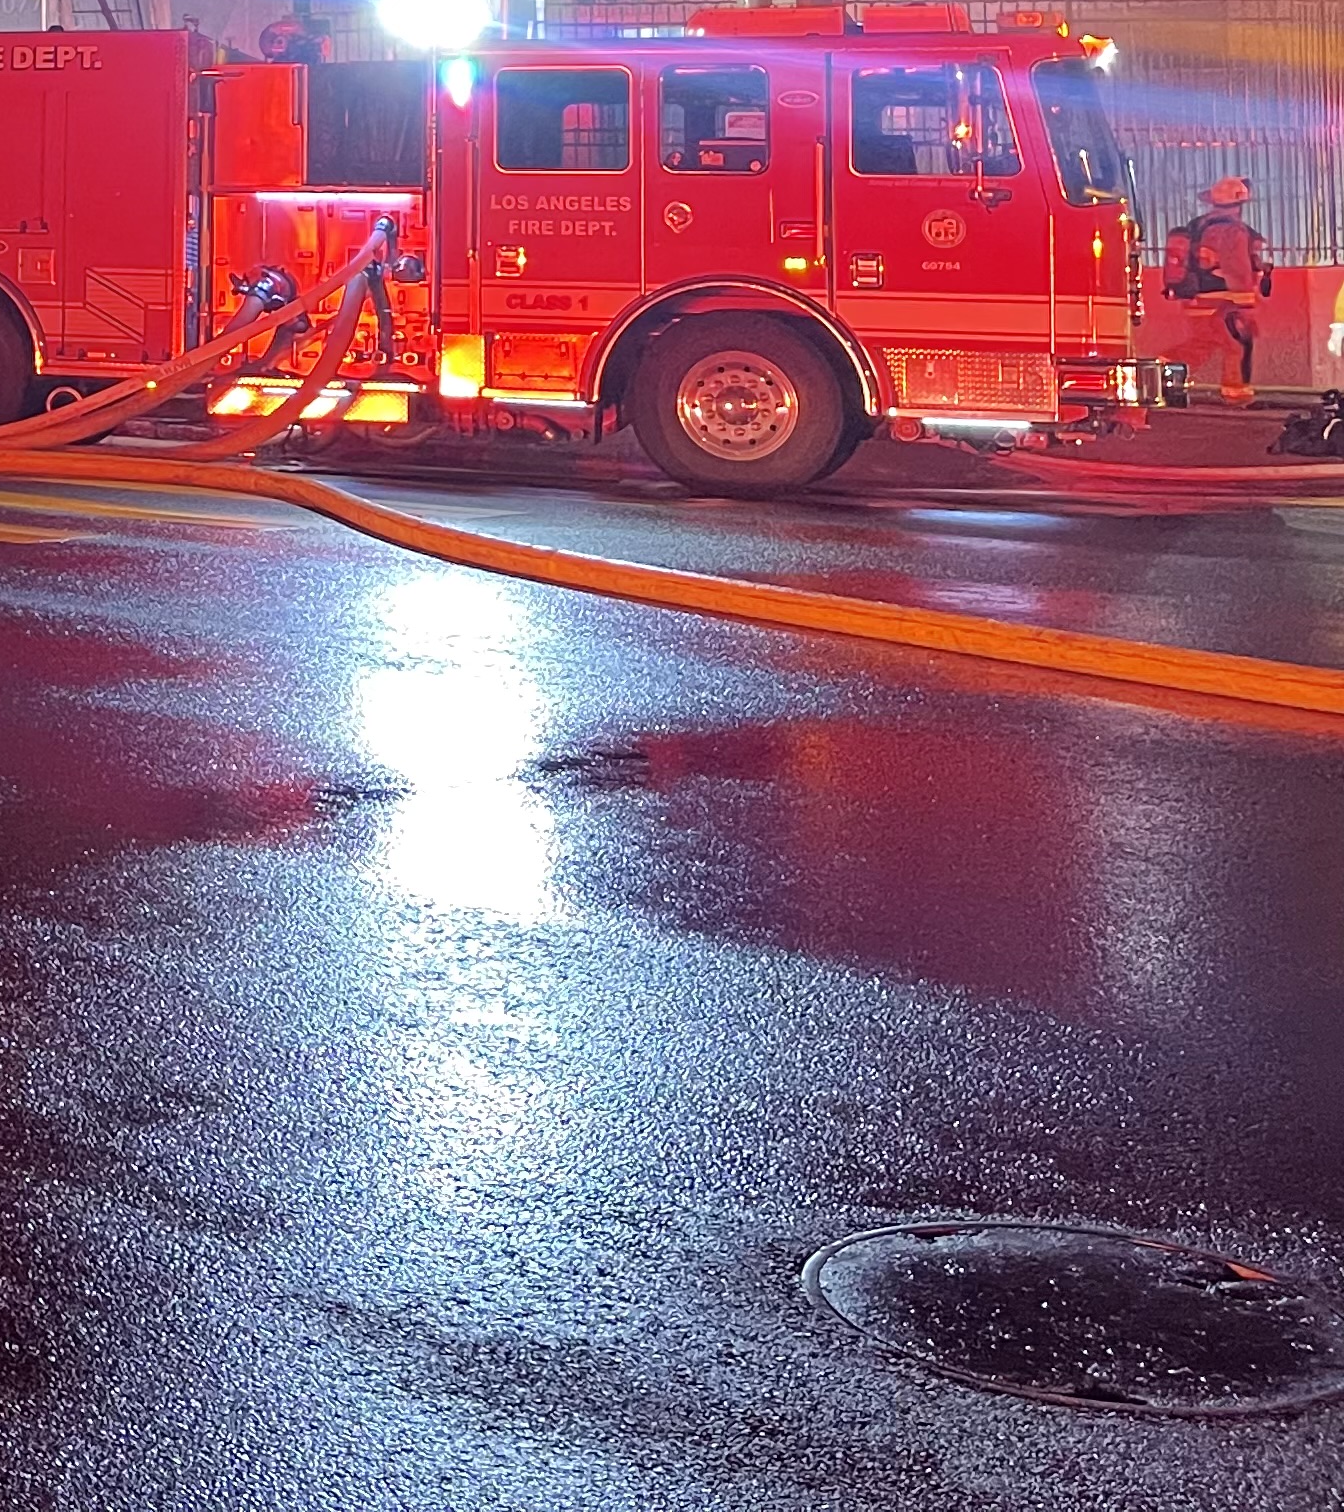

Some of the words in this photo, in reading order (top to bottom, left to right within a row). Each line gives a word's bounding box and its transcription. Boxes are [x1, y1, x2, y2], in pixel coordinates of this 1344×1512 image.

[12, 45, 103, 70] DEPT.
[490, 194, 529, 210] LOS
[536, 195, 632, 212] ANGELES
[508, 219, 554, 236] FIRE
[560, 220, 617, 236] DEPT.
[506, 293, 573, 310] CLASS
[578, 295, 589, 311] 1
